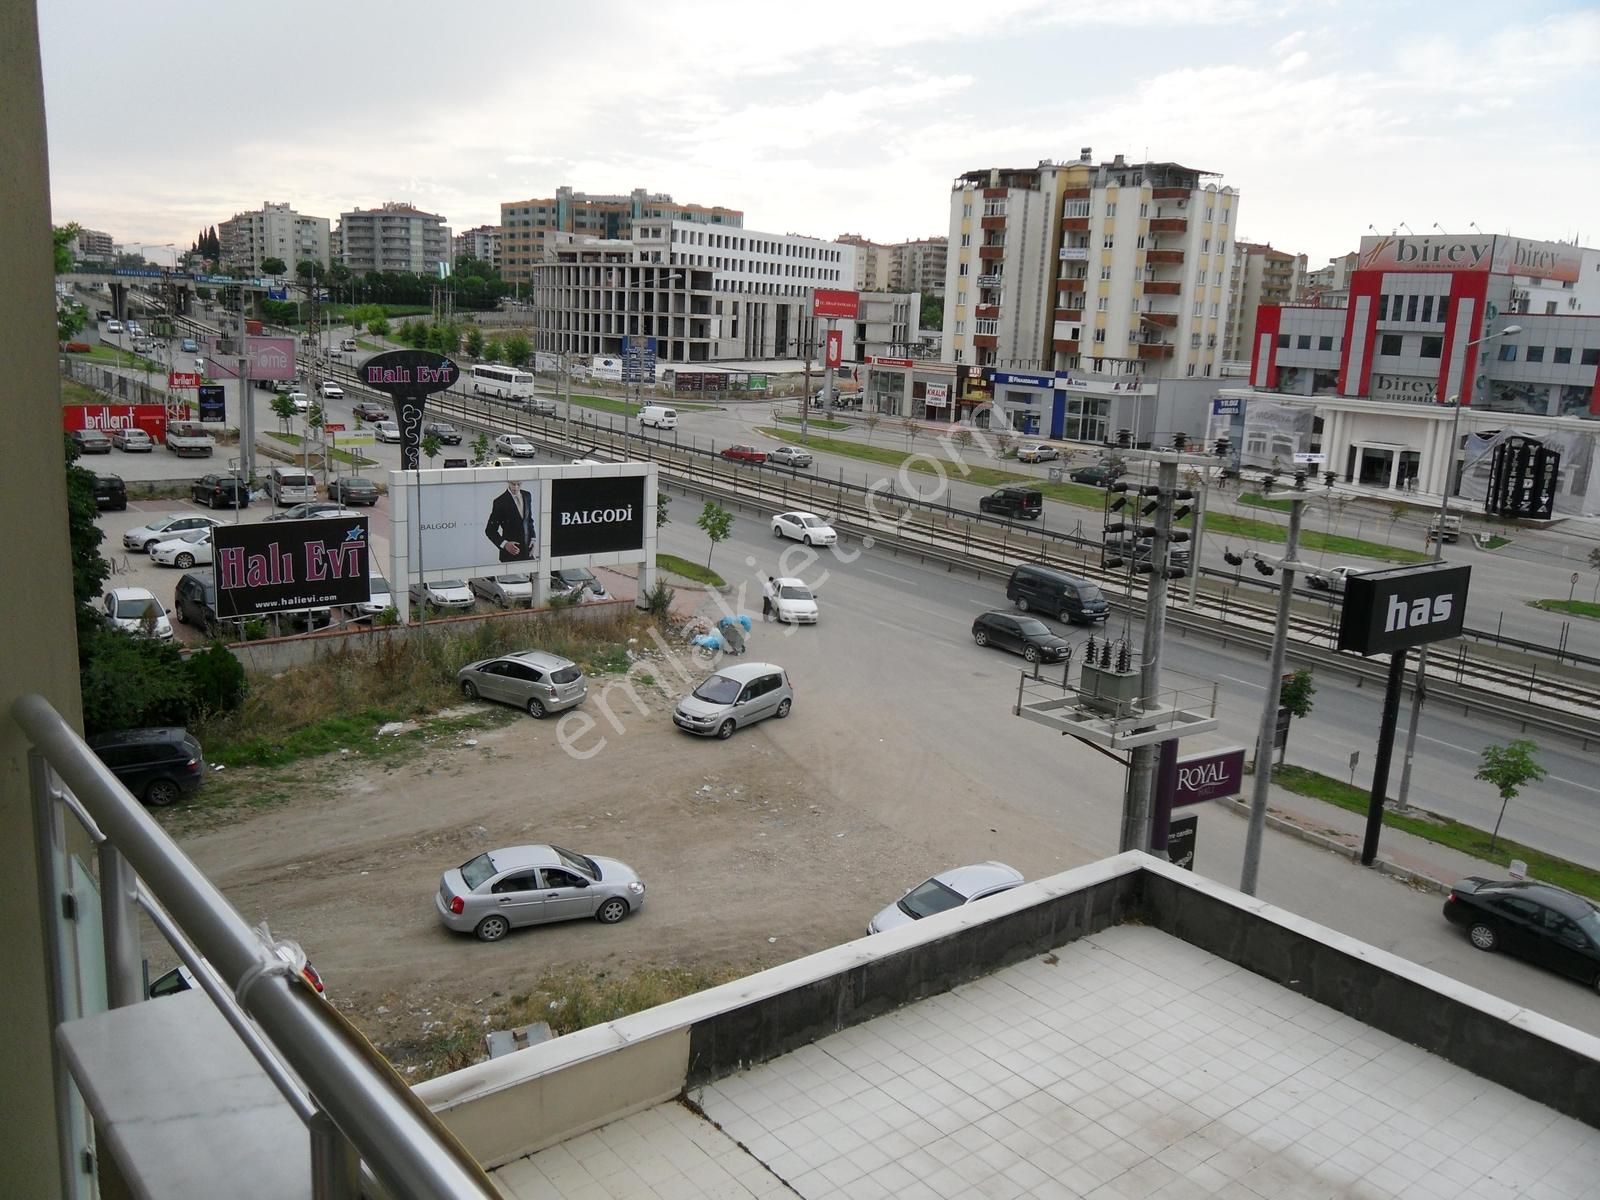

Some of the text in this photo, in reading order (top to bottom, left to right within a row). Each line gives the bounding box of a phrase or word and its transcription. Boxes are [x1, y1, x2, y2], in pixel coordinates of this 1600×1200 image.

[1396, 238, 1489, 267] birey
[1513, 240, 1561, 269] birey
[173, 374, 196, 385] brillant
[1378, 376, 1439, 397] birey
[83, 406, 135, 430] brillant
[561, 504, 633, 526] BALGODİ
[219, 542, 295, 590] Halı
[255, 594, 337, 608] www.halievi.com
[1384, 593, 1453, 633] has
[1176, 761, 1230, 791] ROYAL
